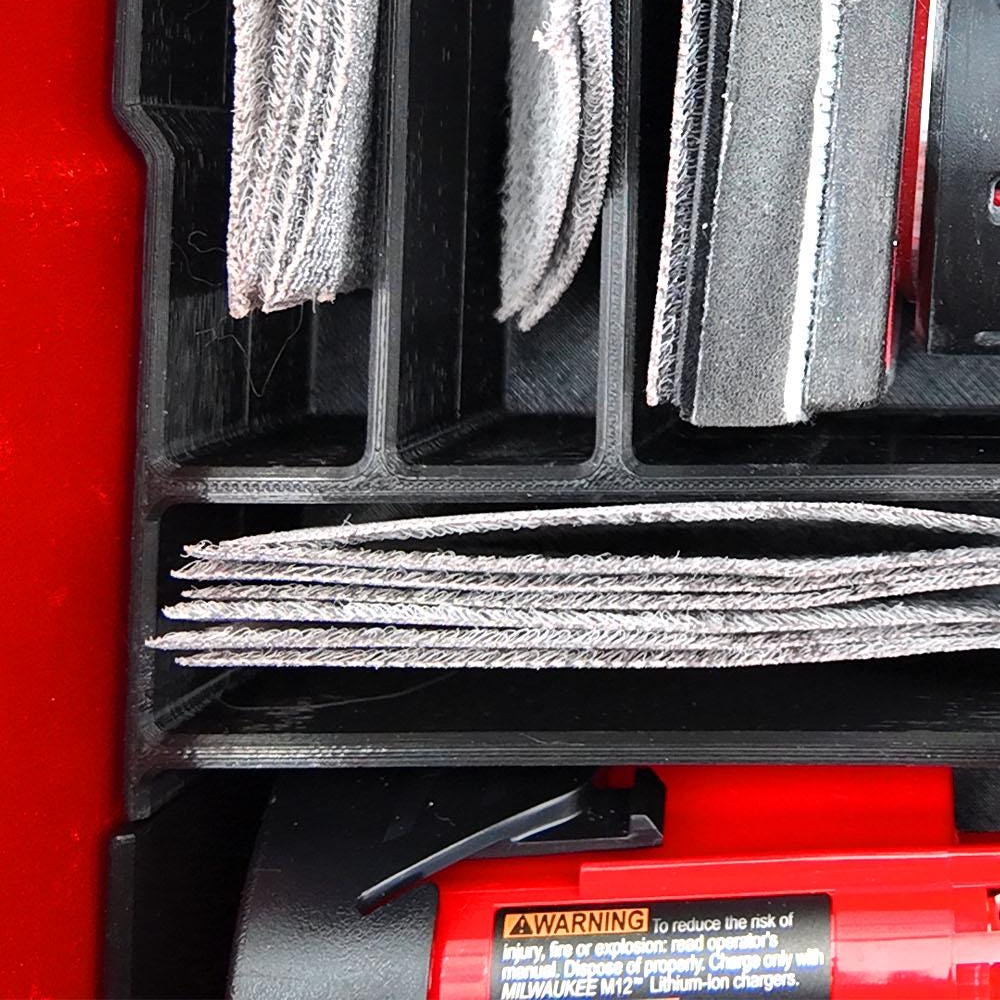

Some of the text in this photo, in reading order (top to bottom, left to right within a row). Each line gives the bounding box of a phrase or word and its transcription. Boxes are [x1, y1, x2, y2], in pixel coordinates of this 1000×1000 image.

[532, 910, 794, 935] WARNING To reduce the risk of
[502, 931, 778, 965] injury, fire or explosion: read operator's
[501, 947, 824, 982] manual. Dispose of properly. Charge only with
[501, 977, 597, 999] MILWAUKEE
[649, 973, 731, 994] Lithium-Ion
[733, 970, 800, 993] chargers.
